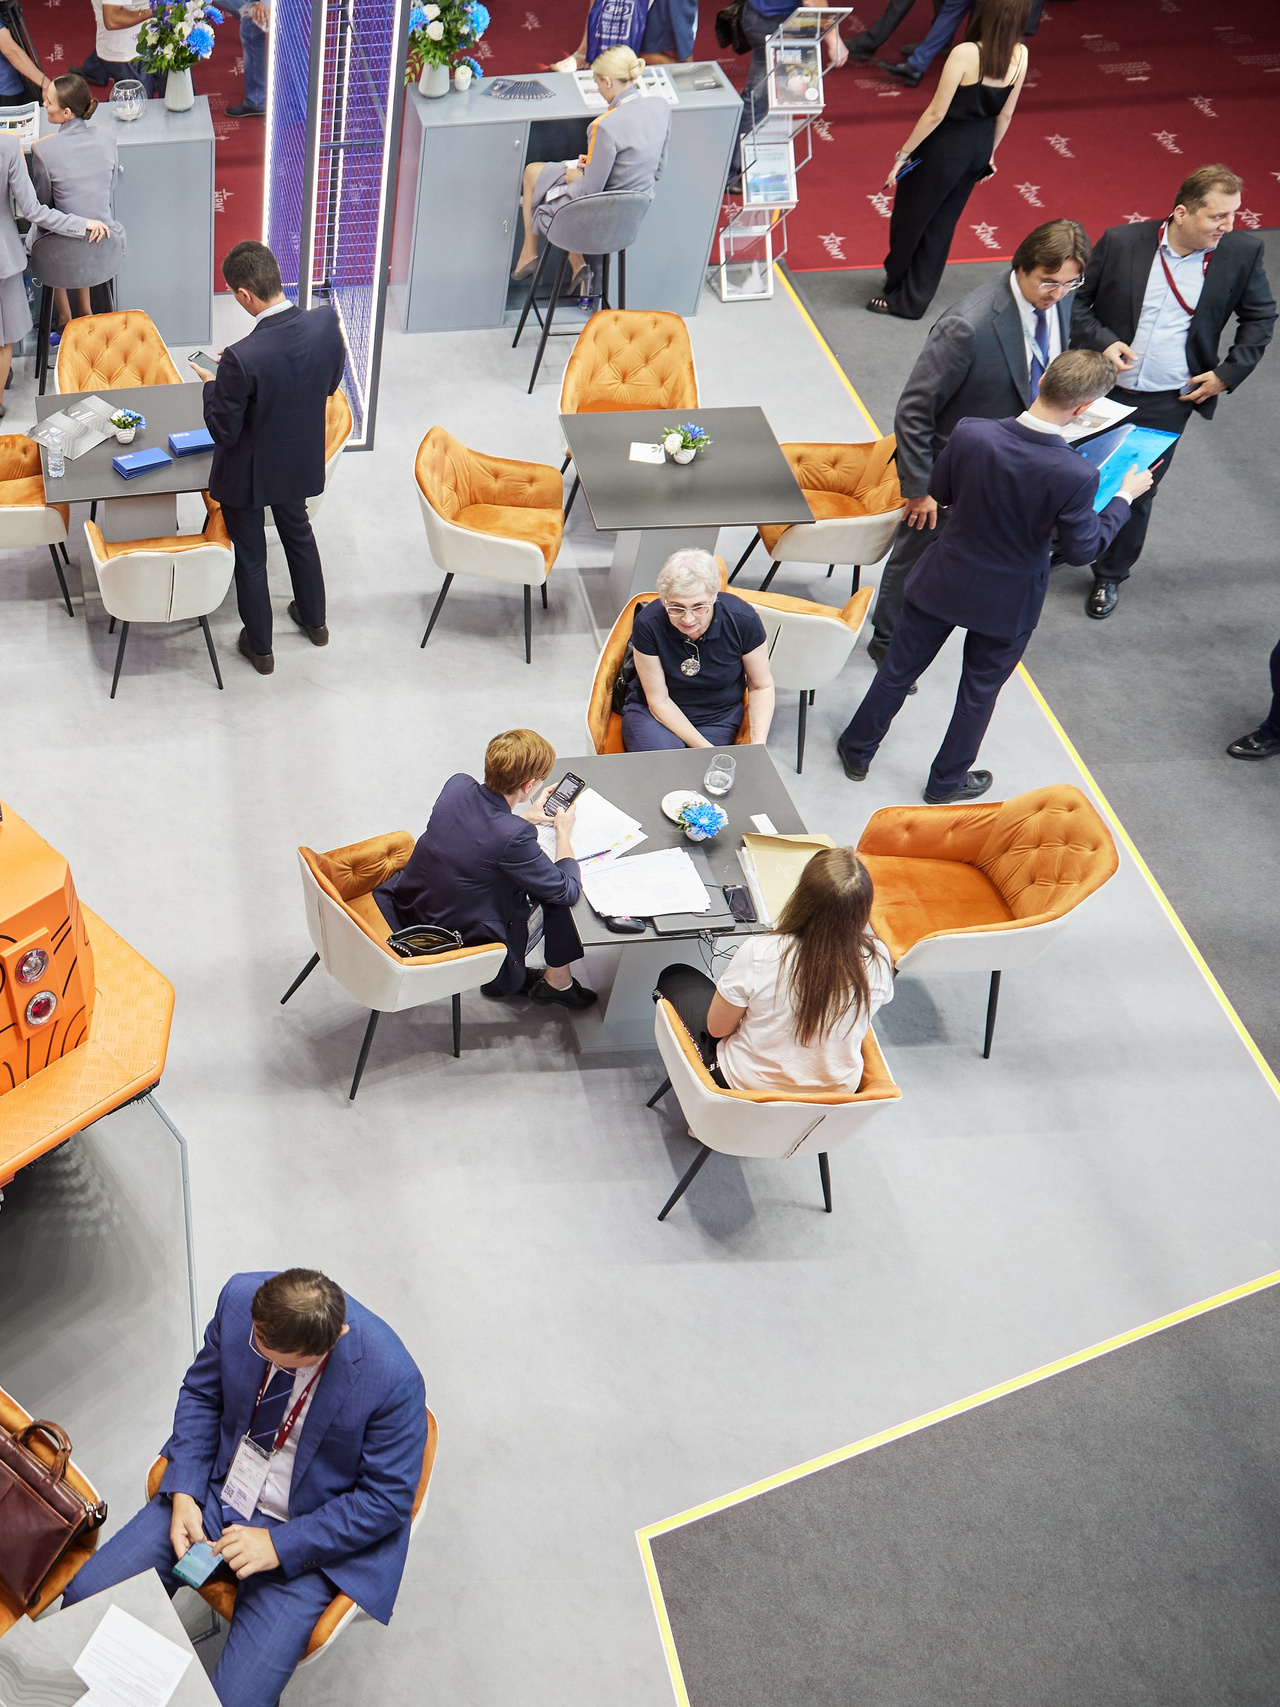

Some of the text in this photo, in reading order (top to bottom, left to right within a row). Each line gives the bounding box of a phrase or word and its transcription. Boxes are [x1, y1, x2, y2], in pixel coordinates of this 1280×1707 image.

[1014, 182, 1046, 208] ARMY
[817, 232, 847, 260] ARMY
[970, 221, 1001, 250] ARMY
